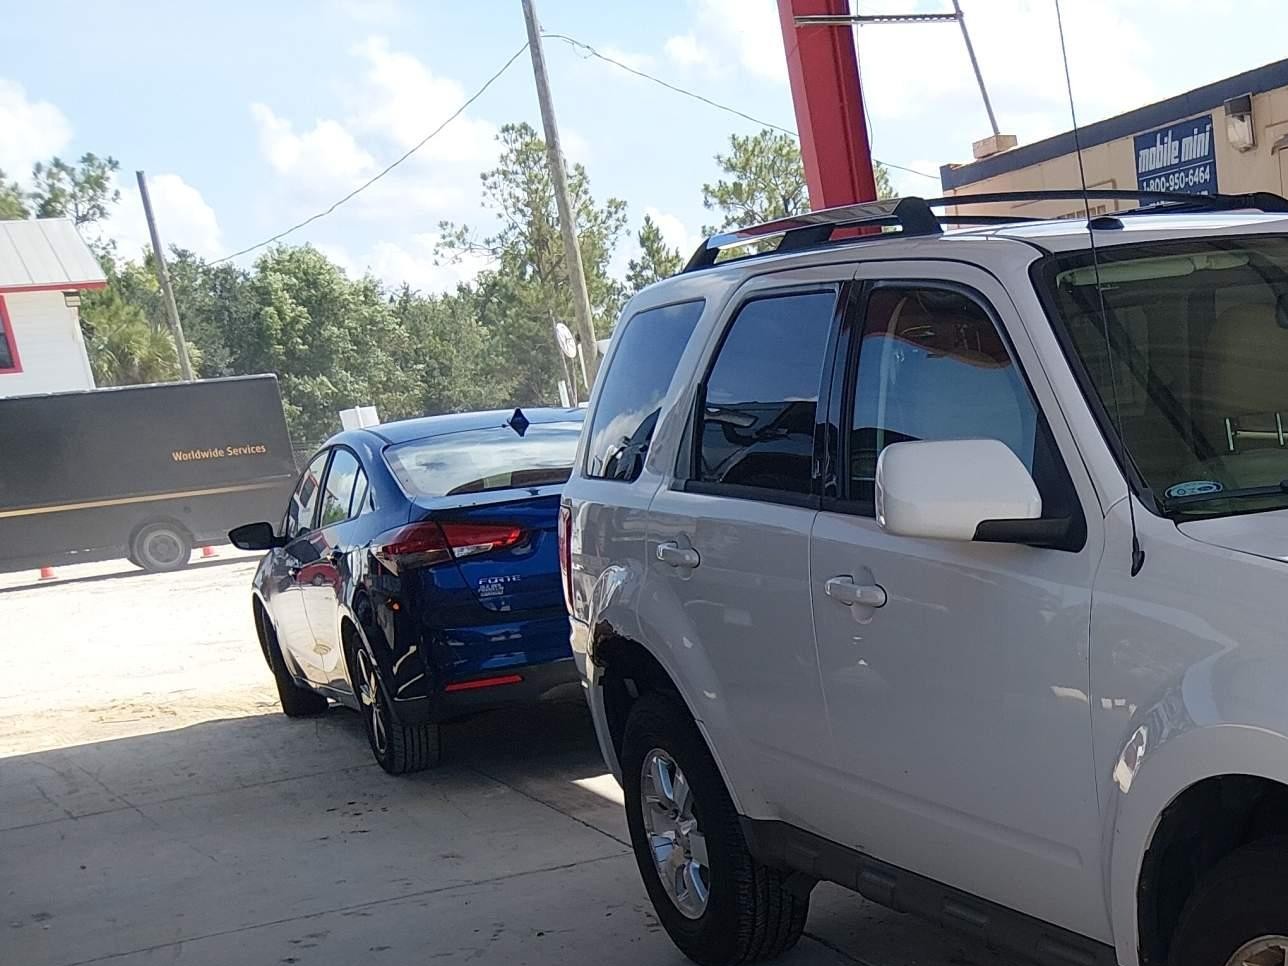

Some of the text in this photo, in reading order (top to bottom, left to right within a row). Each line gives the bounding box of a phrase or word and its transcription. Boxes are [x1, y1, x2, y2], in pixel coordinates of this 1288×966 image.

[1138, 126, 1211, 173] mobile mini
[1143, 165, 1210, 192] 1-800-950-6464
[172, 445, 266, 461] Worldwide Services
